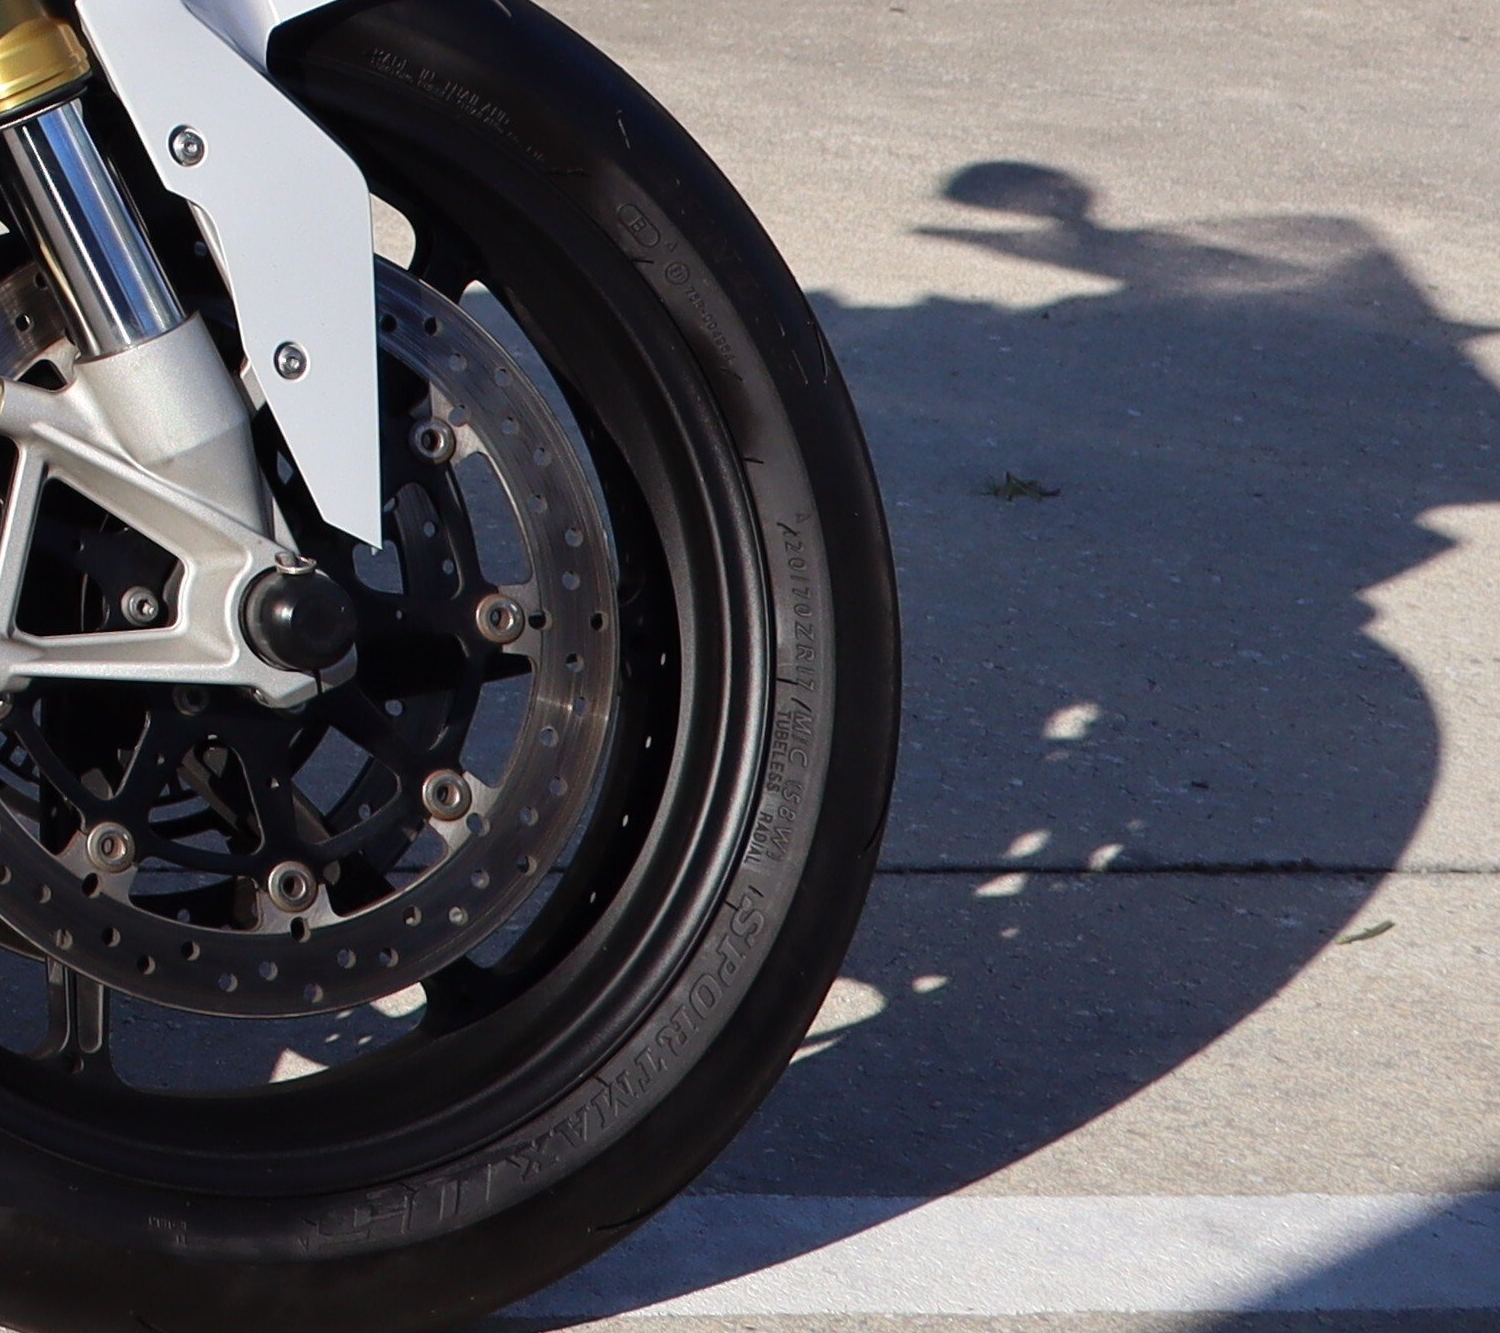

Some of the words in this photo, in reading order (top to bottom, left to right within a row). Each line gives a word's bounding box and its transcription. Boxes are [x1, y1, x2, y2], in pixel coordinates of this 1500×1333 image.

[764, 708, 792, 795] TUBELESS
[742, 809, 774, 869] RADIAL
[509, 893, 773, 1182] SPORTMAX
